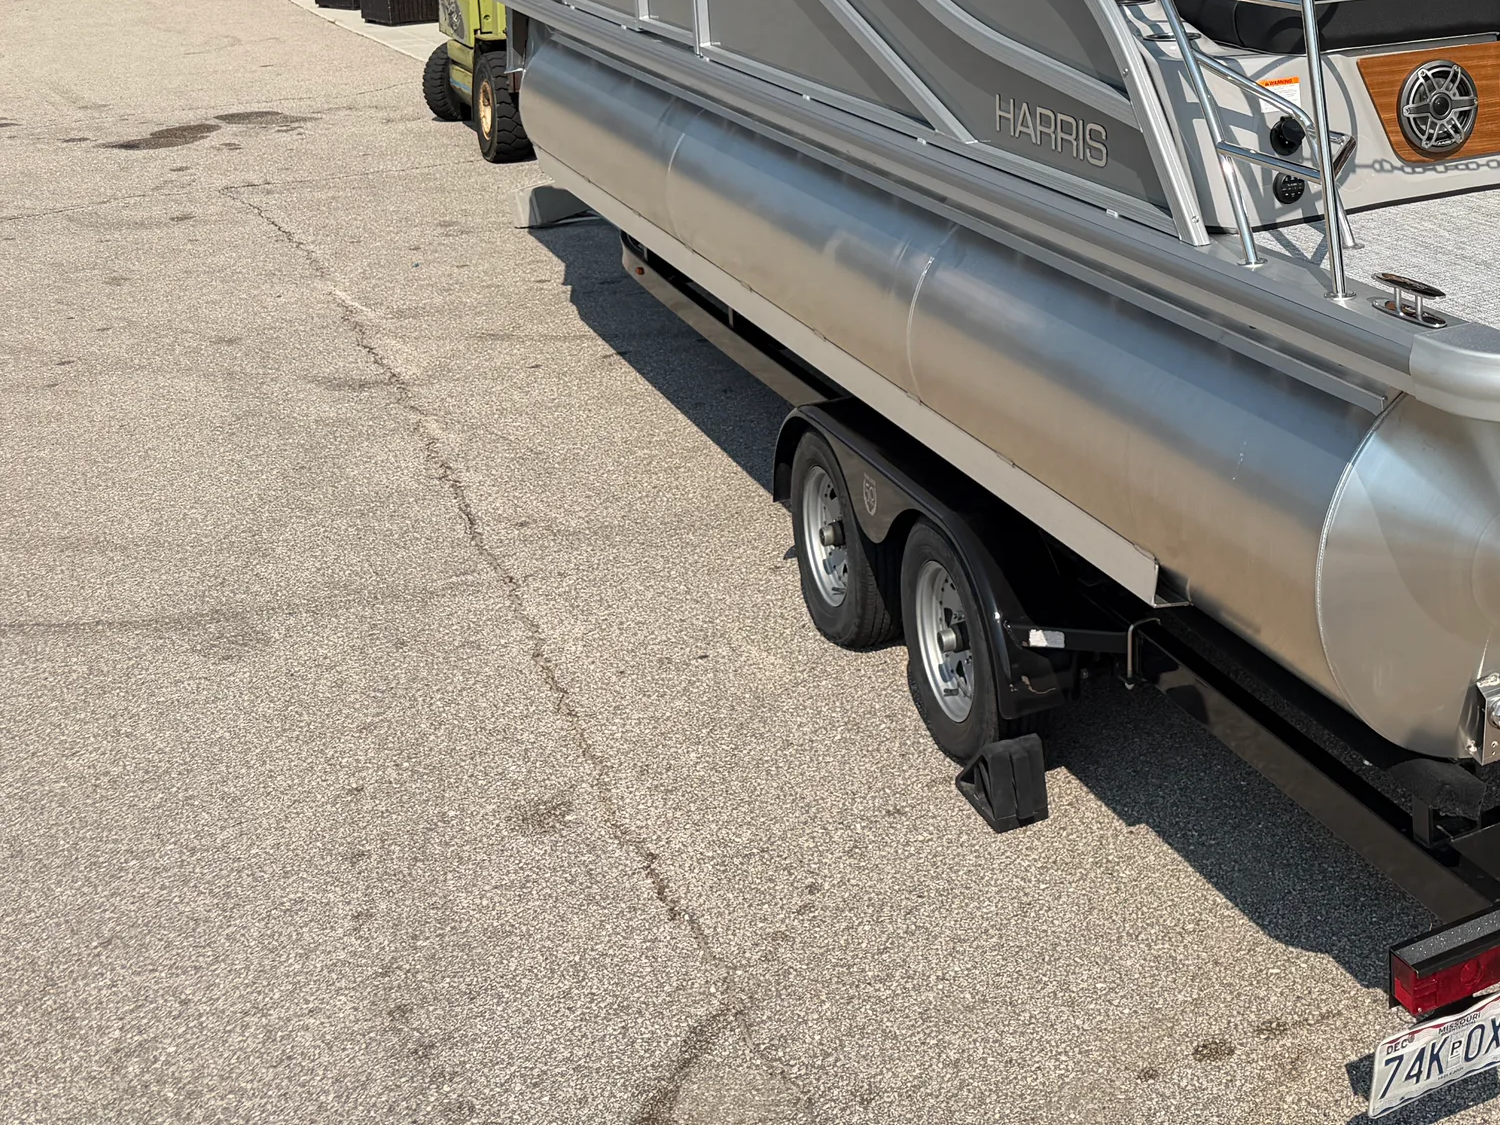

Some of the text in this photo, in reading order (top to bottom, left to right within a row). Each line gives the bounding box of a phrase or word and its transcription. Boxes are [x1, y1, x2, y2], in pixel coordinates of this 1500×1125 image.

[995, 93, 1108, 168] HARRIS
[1438, 1011, 1481, 1035] MISSOURI
[1378, 1035, 1450, 1100] 74K
[1386, 1039, 1409, 1056] DEC
